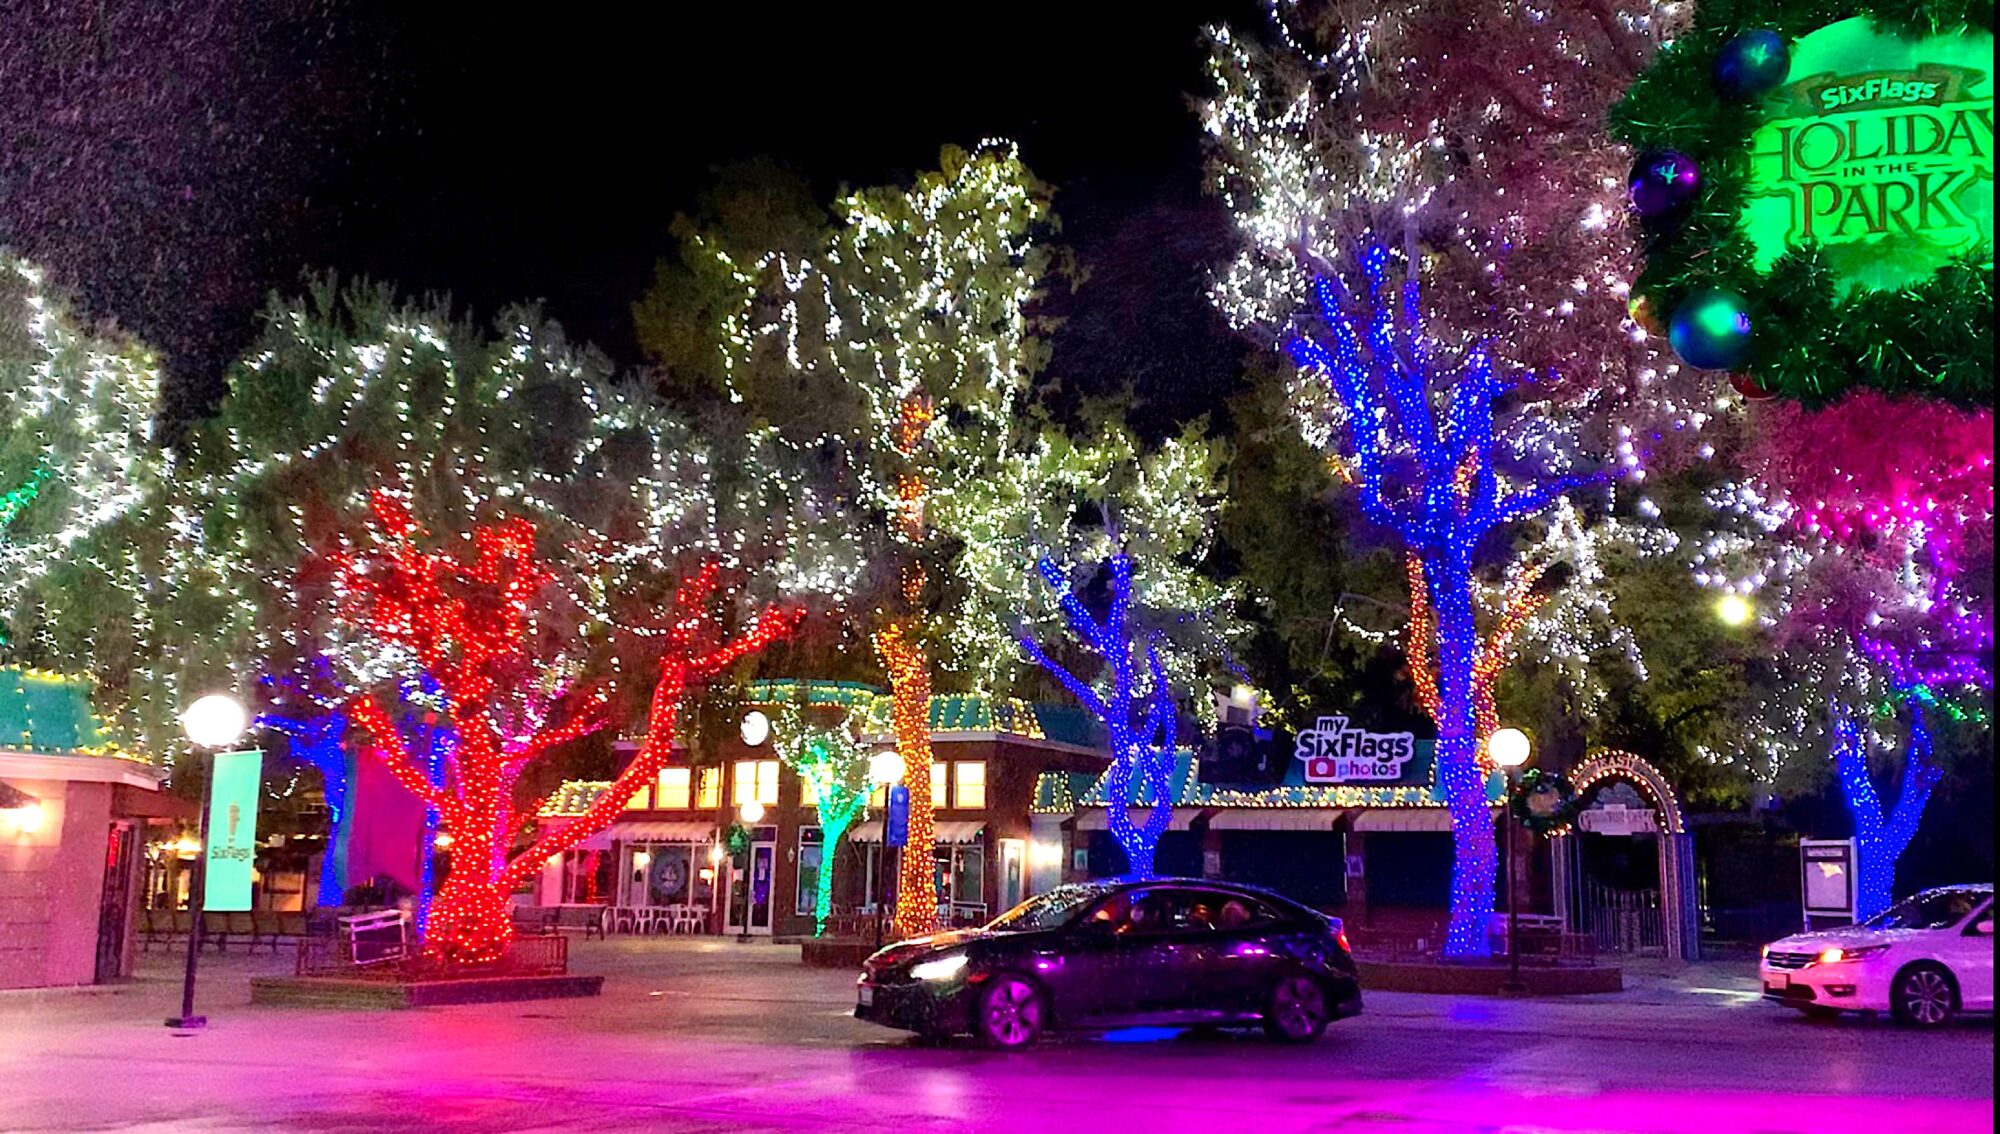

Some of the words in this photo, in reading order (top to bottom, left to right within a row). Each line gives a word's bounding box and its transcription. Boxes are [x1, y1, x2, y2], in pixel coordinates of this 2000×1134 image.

[1820, 78, 1941, 109] SixFlags
[1843, 166, 1866, 178] IN
[1874, 162, 1919, 175] THE
[1800, 170, 1966, 239] PARK
[1319, 719, 1345, 736] my
[1299, 731, 1411, 763] SixFlags
[1338, 760, 1397, 778] photos
